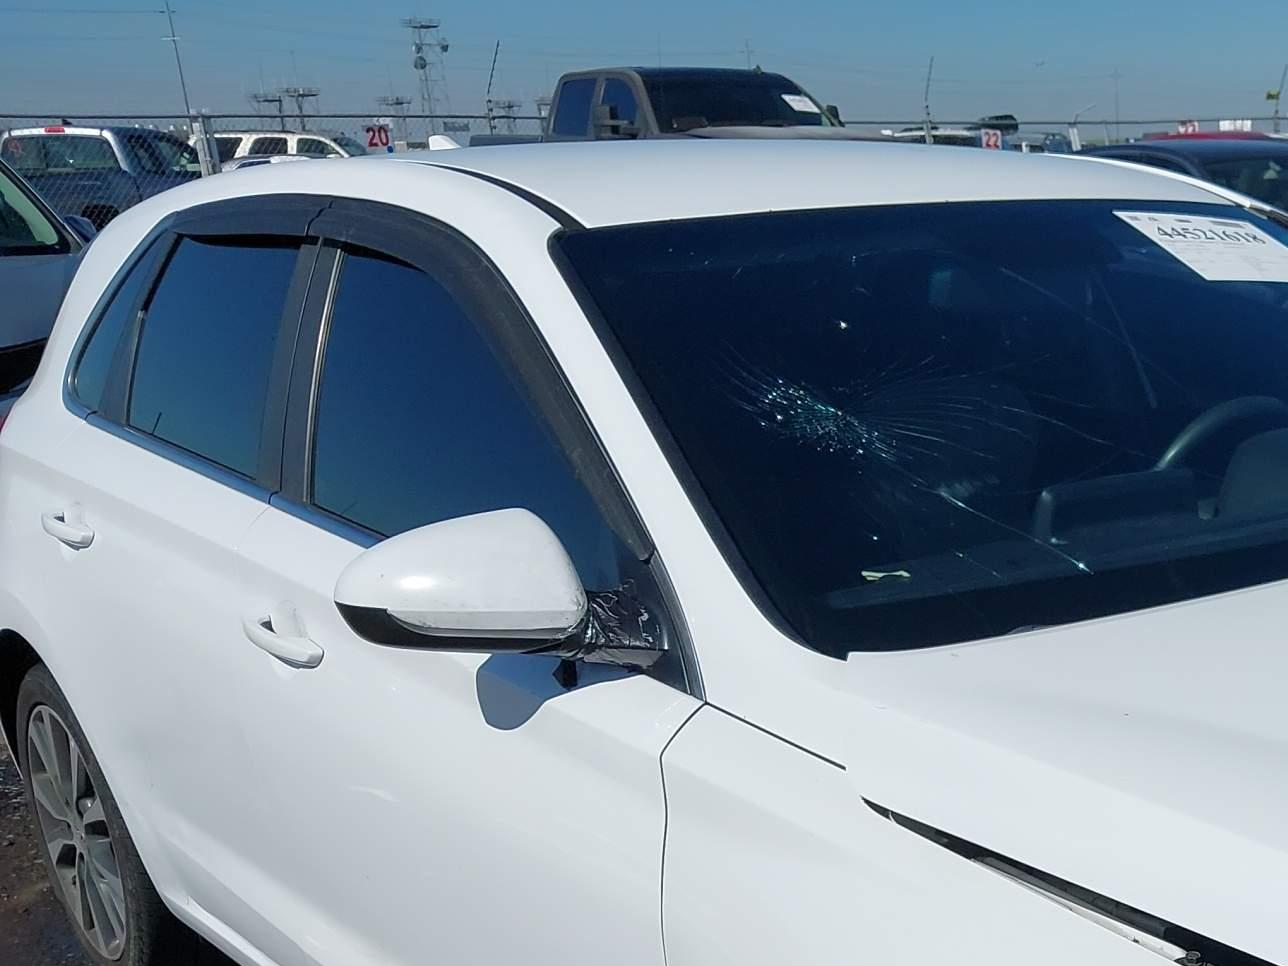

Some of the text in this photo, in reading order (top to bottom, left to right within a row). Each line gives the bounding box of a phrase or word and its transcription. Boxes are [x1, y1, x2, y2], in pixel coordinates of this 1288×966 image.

[366, 126, 389, 147] 20
[984, 131, 1000, 148] 22
[1156, 225, 1267, 245] 44521618
